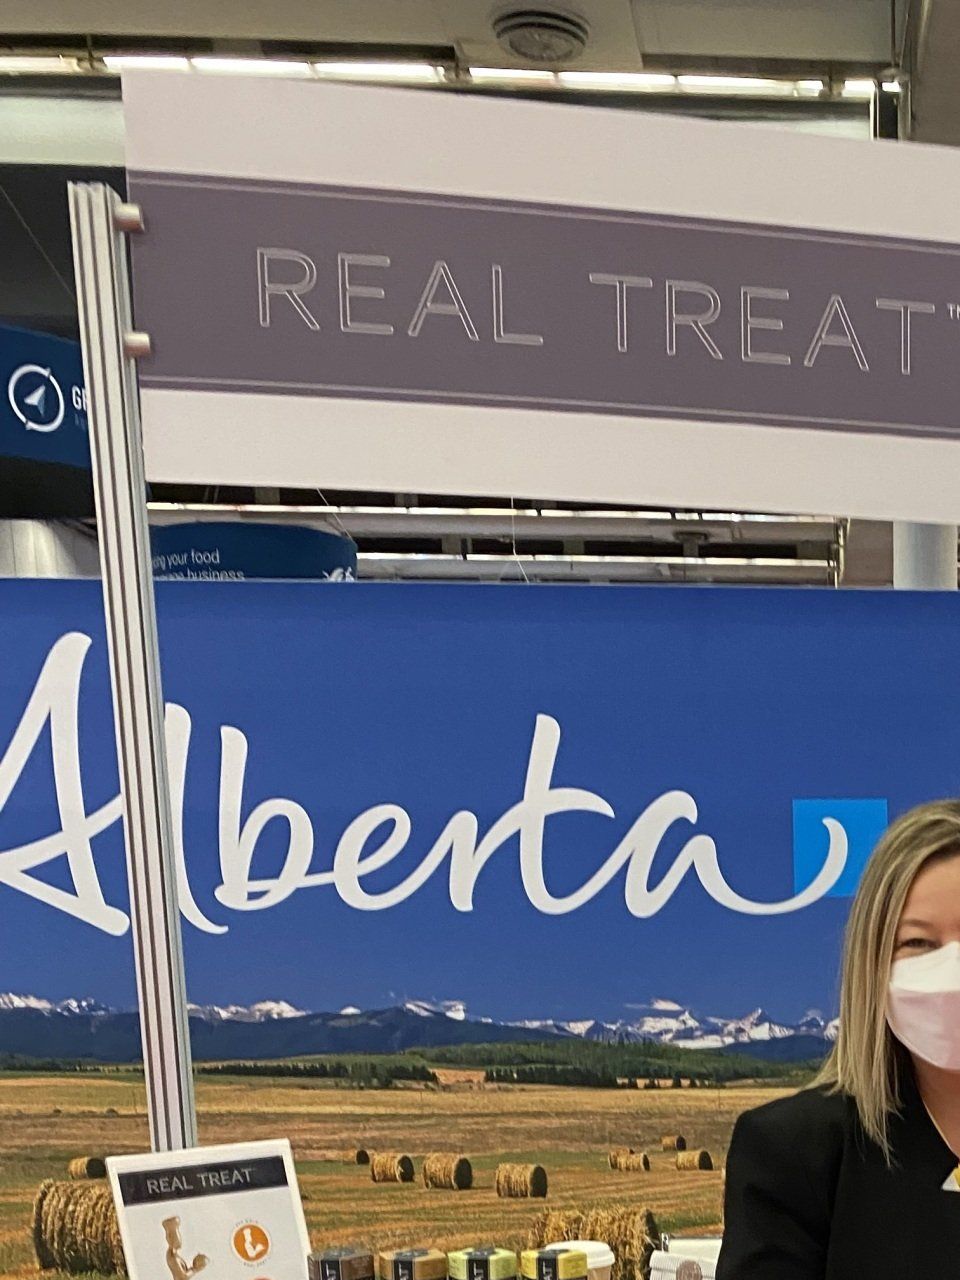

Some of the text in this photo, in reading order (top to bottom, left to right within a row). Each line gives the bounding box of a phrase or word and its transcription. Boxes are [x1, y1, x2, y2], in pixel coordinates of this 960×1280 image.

[256, 247, 543, 345] REAL
[0, 631, 848, 934] Alberta
[147, 1168, 252, 1195] REAL TREAT
